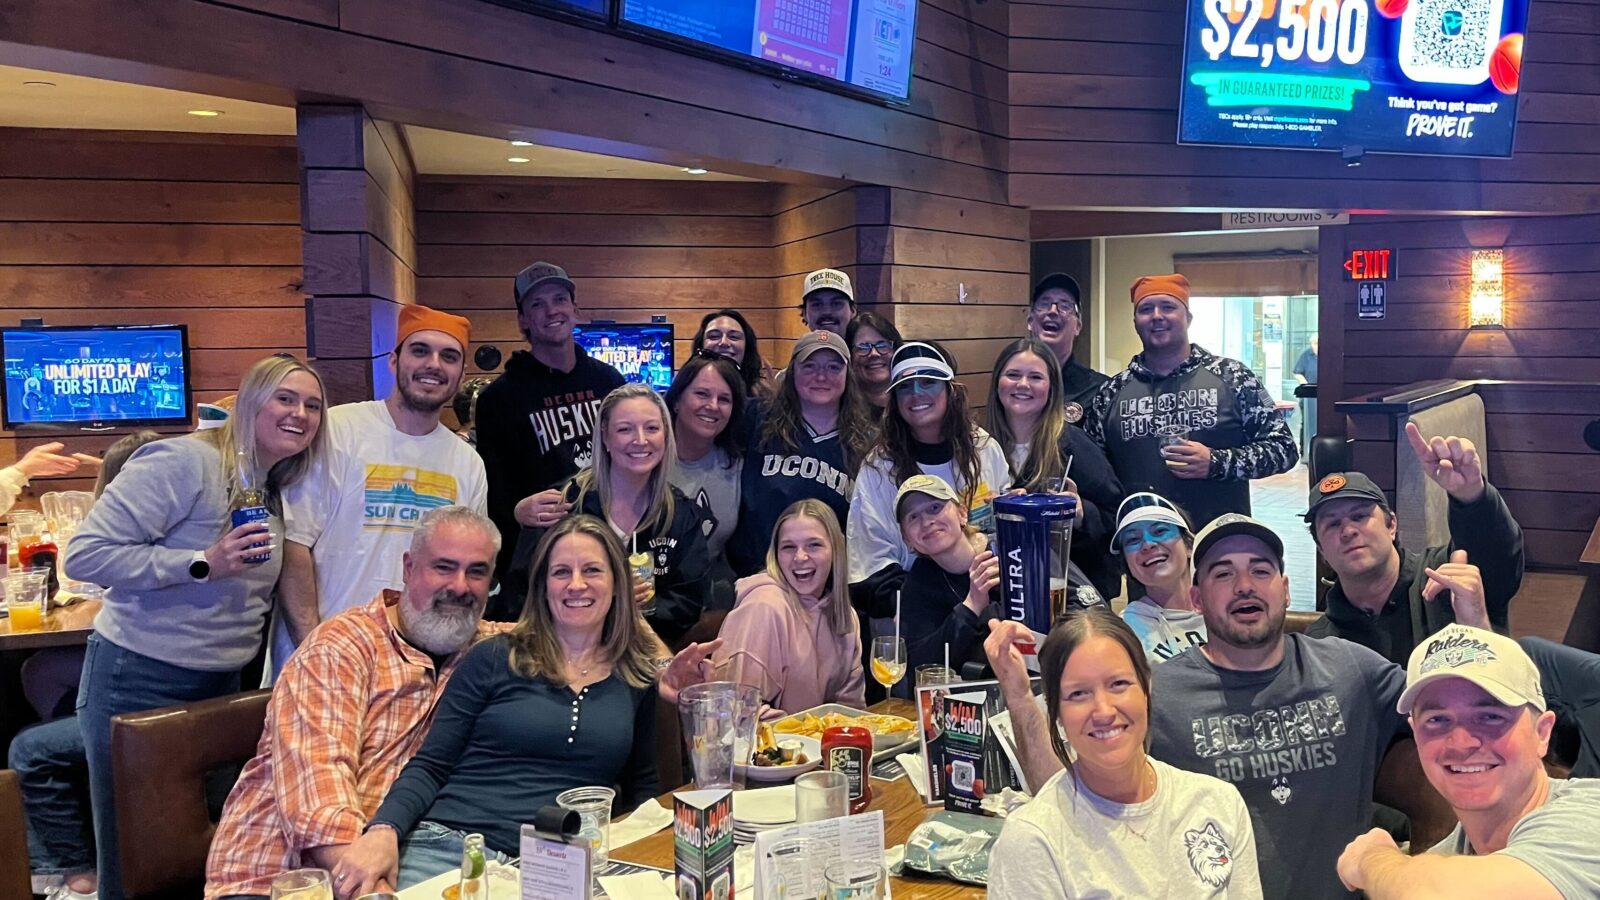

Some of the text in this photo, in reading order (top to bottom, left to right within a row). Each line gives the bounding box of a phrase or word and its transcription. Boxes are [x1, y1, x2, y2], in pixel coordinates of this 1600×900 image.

[1201, 0, 1369, 67] $2,500
[1218, 79, 1345, 101] IN GUARANTEED PRIZES!
[1388, 96, 1498, 113] Think you've got game?
[1406, 113, 1475, 138] PROVE IT.
[1352, 249, 1390, 284] EXIT
[627, 350, 652, 363] PLAY
[45, 362, 152, 380] UNLIMITED PLAY
[54, 378, 138, 396] FOR $1 A DAY
[1119, 388, 1218, 418] UCONN
[1120, 406, 1218, 441] HUSKIES
[364, 505, 396, 519] SUN
[1009, 547, 1026, 622] ULTRA
[1420, 633, 1490, 665] Raiders
[945, 712, 982, 736] $2,500
[950, 702, 976, 722] WIN
[1192, 696, 1346, 758] UCONN
[1215, 742, 1338, 782] GO HUSKIES
